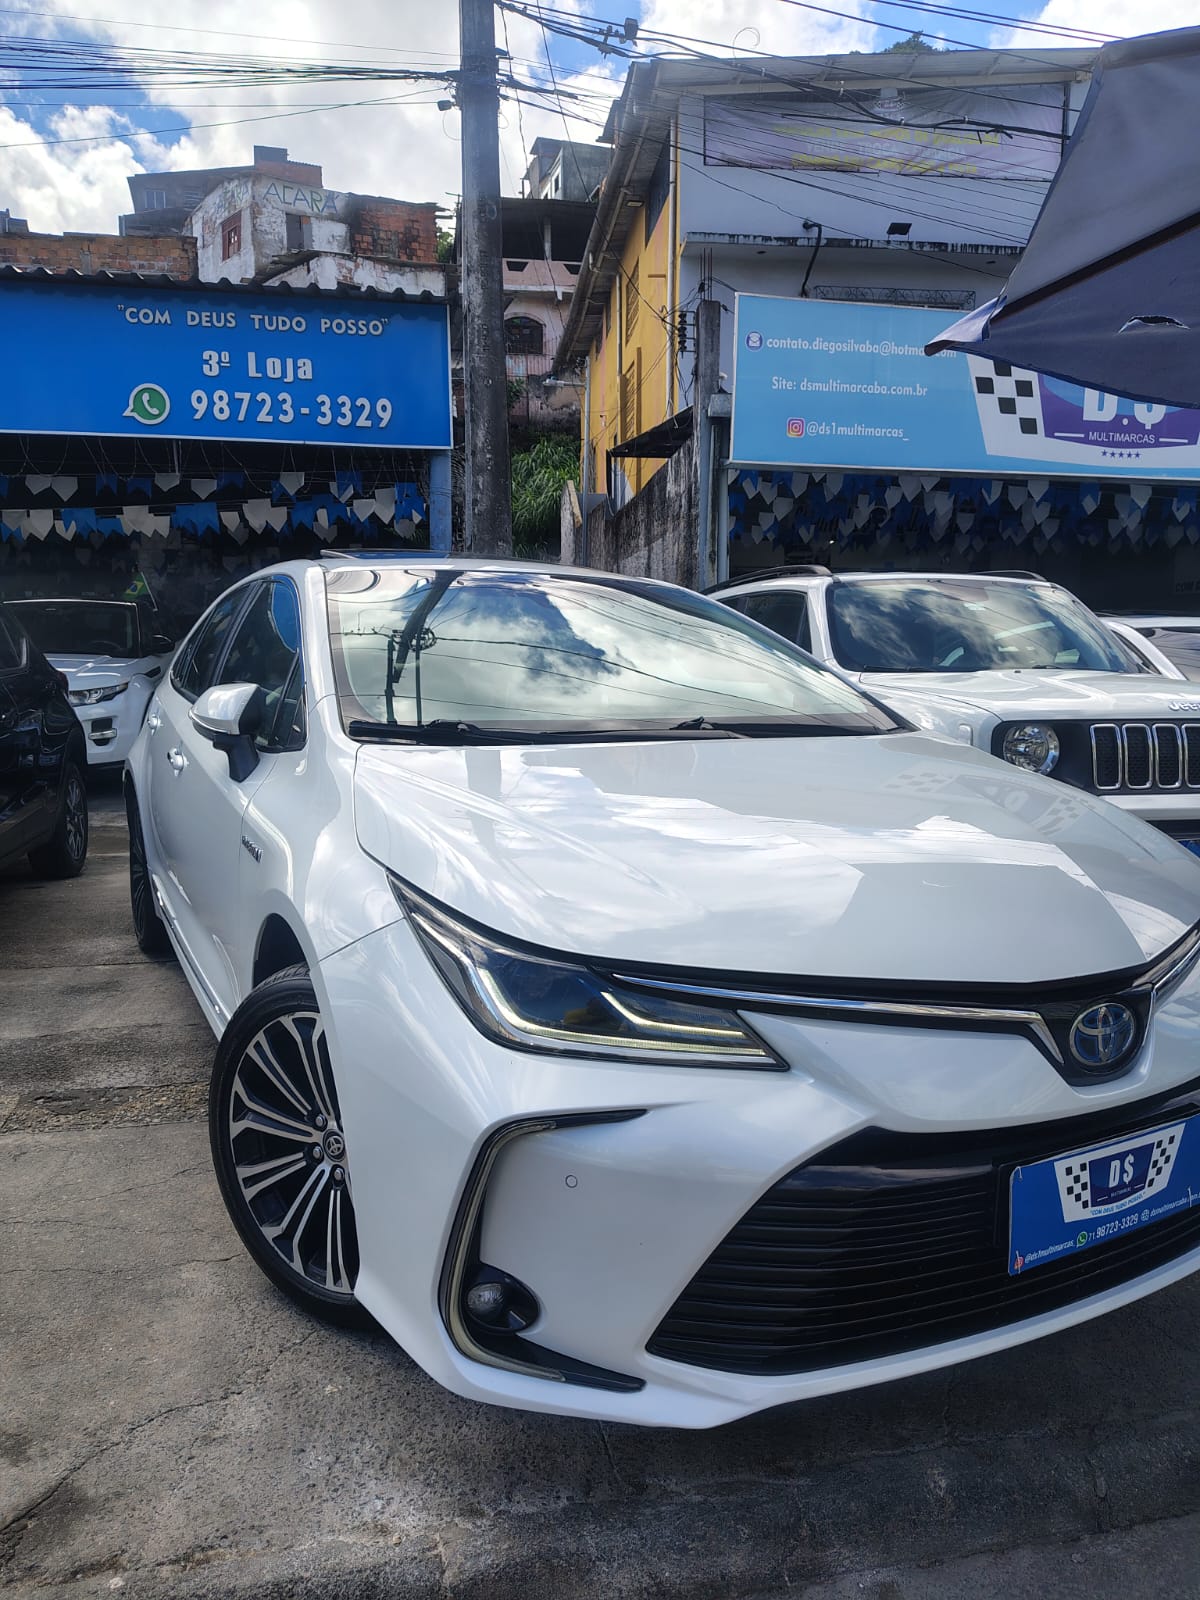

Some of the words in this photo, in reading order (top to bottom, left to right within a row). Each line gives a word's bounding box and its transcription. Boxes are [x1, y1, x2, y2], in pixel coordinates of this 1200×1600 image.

[187, 310, 236, 329] DEUS
[250, 314, 306, 333] TUDO
[248, 352, 313, 383] Loja
[771, 376, 797, 392] Site:
[800, 378, 928, 398] dsmultimarcaba.com.br
[190, 389, 393, 428] 98723-3329
[1088, 431, 1156, 444] MULTIMARCAS
[1168, 700, 1200, 712] Jee
